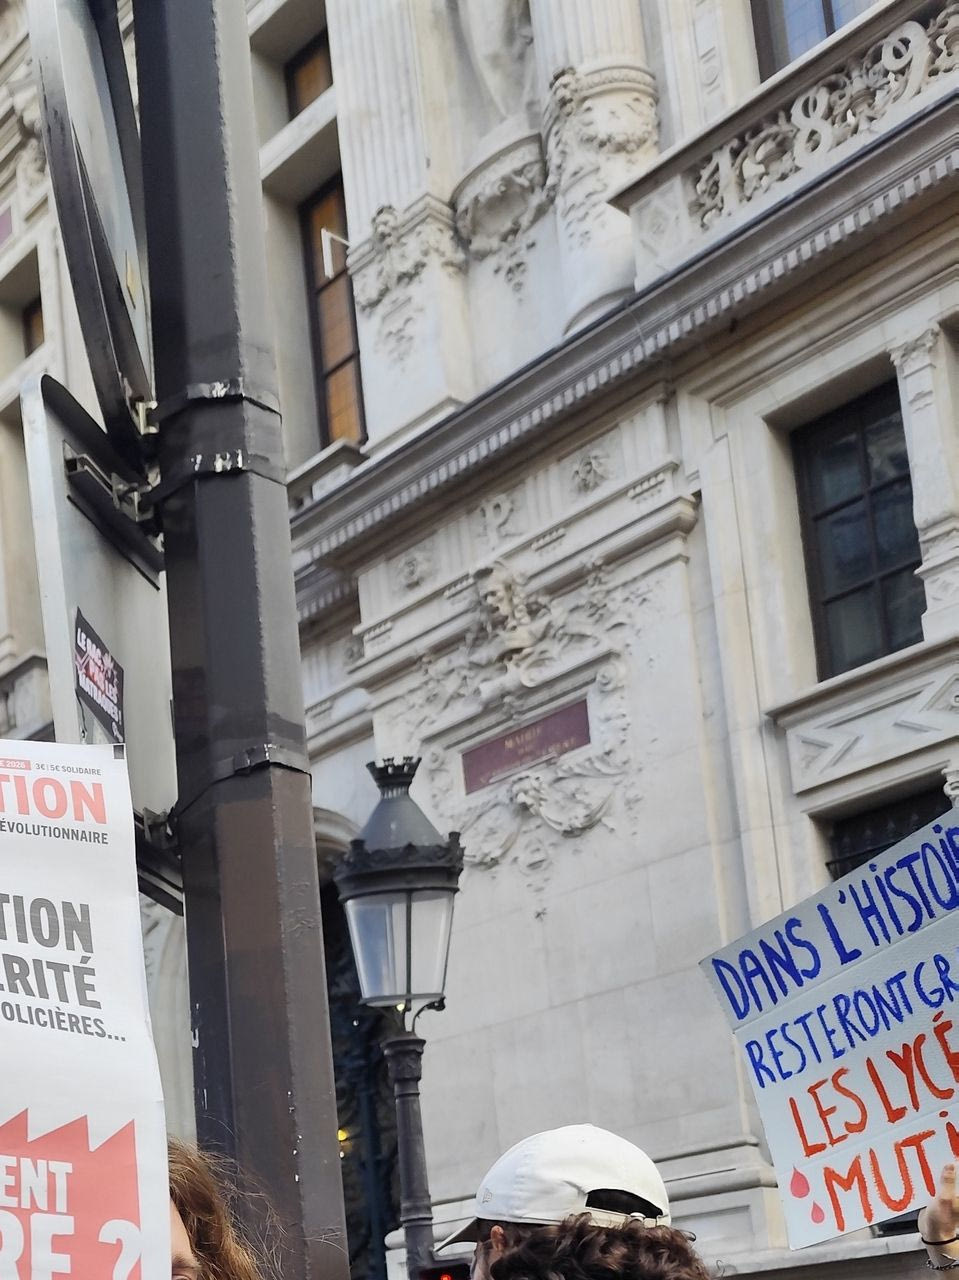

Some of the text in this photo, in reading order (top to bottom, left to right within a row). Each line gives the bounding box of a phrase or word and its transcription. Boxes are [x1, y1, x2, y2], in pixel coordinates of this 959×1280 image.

[61, 765, 102, 776] SOLIDAIRE
[711, 917, 822, 1021] DANS
[745, 970, 913, 1089] RESTERONT
[788, 1067, 868, 1159] LES
